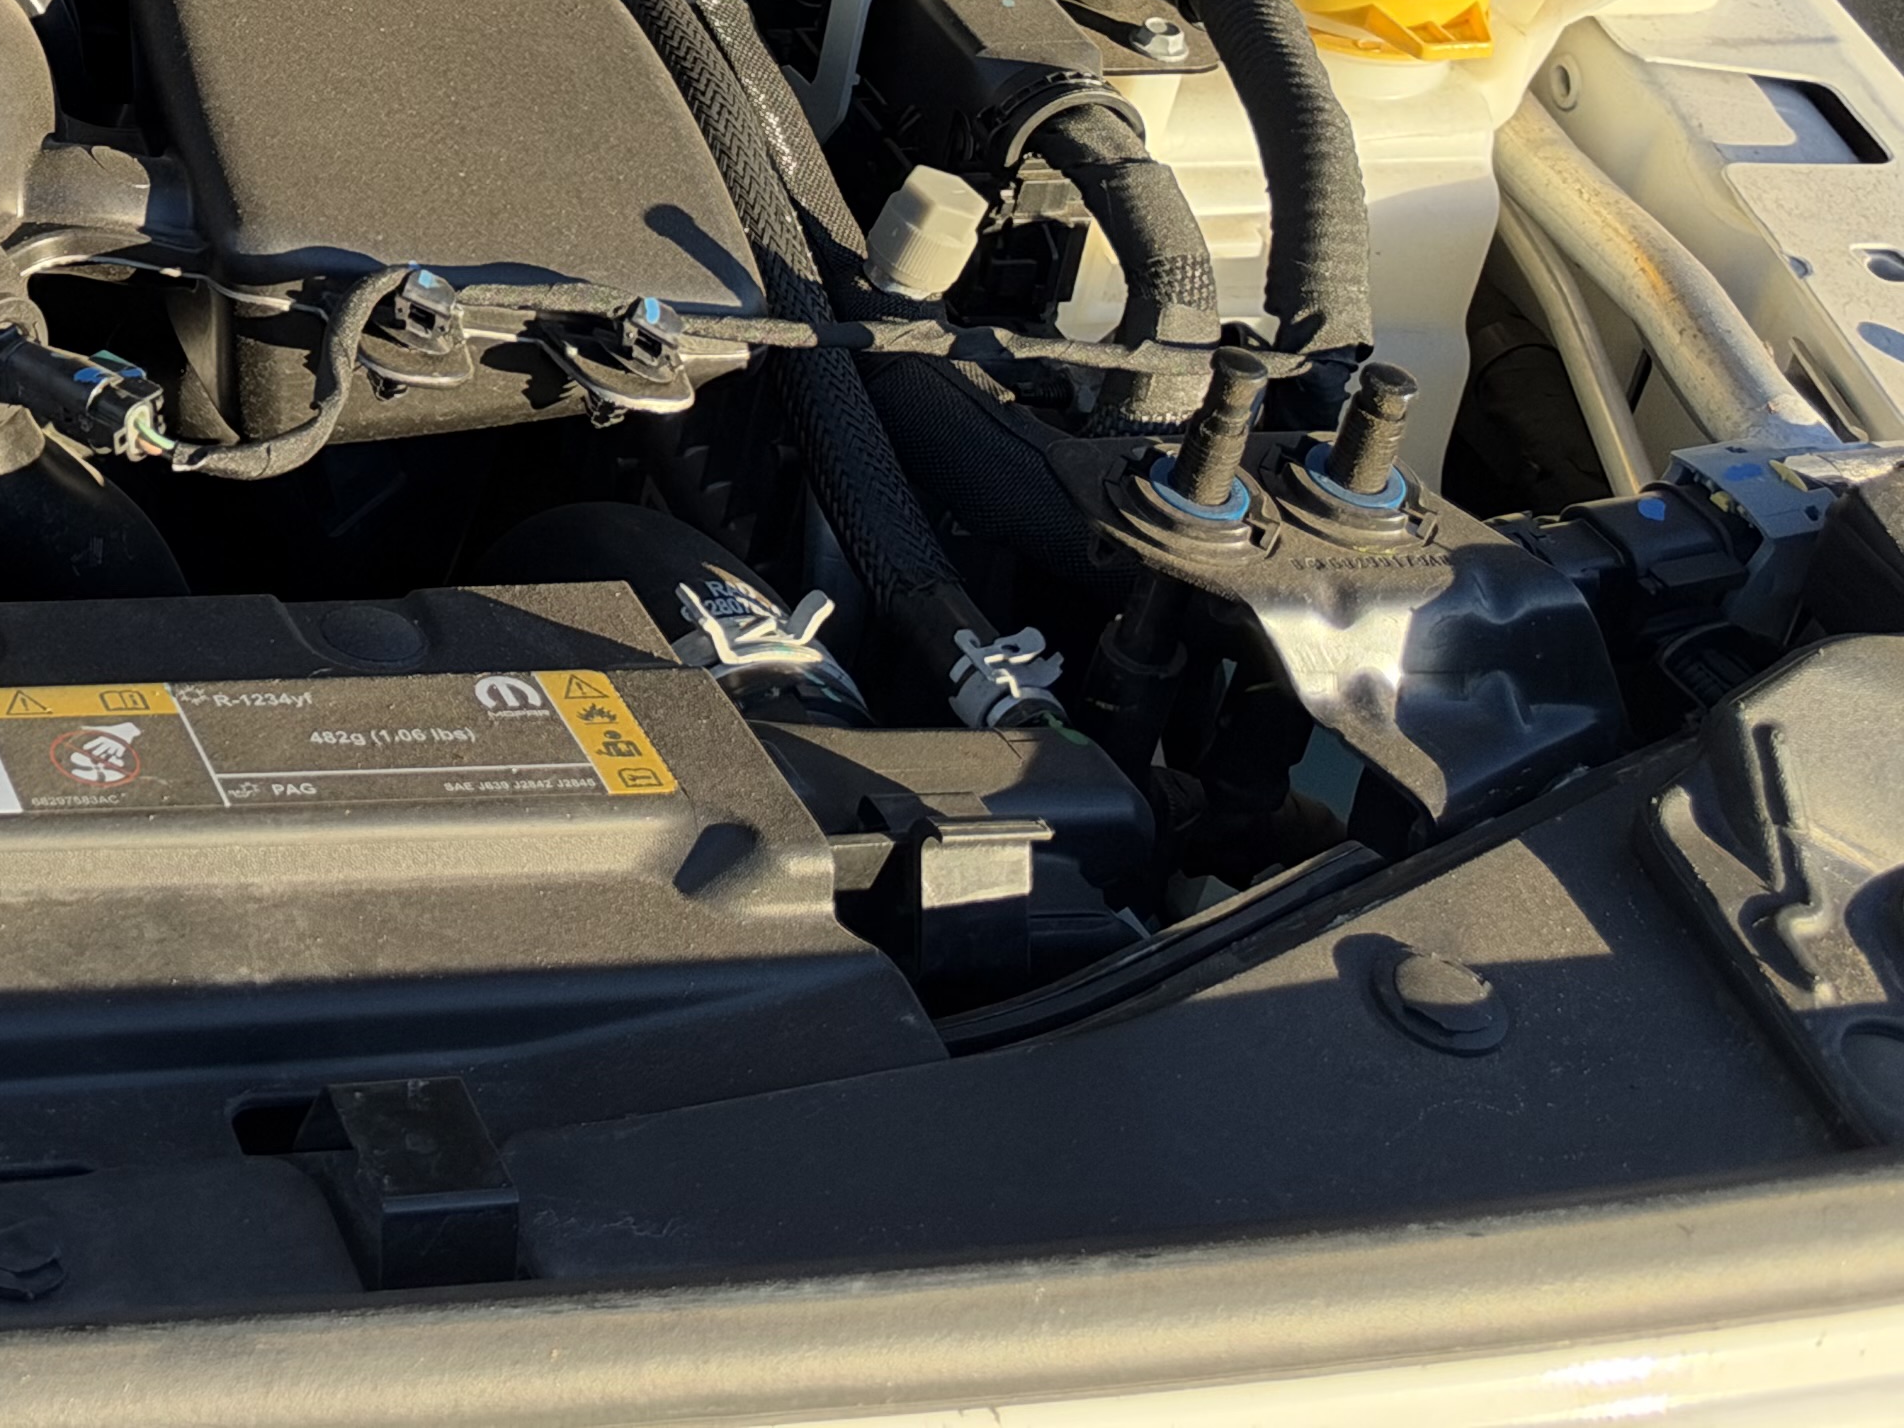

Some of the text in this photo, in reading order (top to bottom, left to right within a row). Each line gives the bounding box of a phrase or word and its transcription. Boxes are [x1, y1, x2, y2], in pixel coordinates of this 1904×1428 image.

[212, 692, 551, 719] R-1234yf MOPAR
[309, 726, 477, 747] 482g (1.06 lbs)
[271, 782, 318, 795] PAG
[443, 781, 473, 793] SAE
